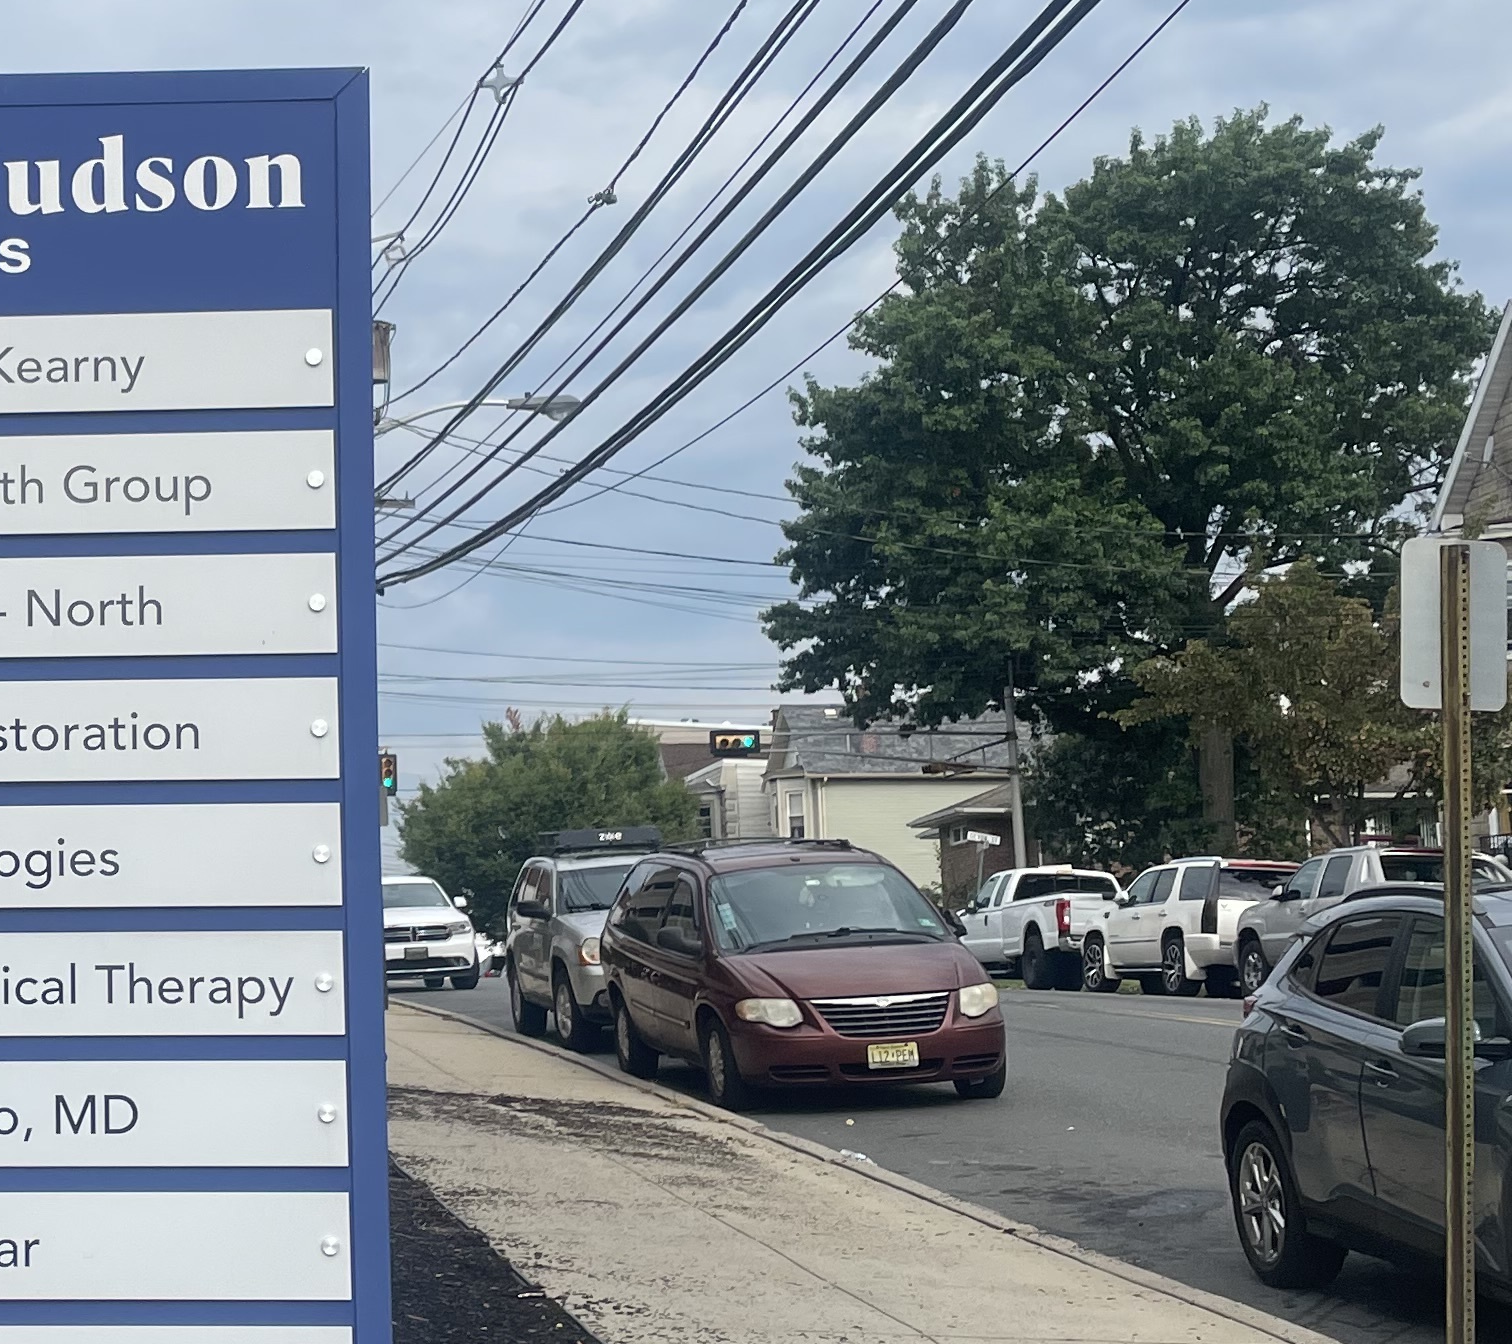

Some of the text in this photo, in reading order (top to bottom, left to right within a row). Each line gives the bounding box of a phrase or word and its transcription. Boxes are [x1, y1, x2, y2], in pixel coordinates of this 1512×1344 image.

[63, 464, 212, 517] Group
[27, 584, 163, 628] North
[94, 961, 295, 1020] Therapy
[54, 1094, 139, 1135] MD
